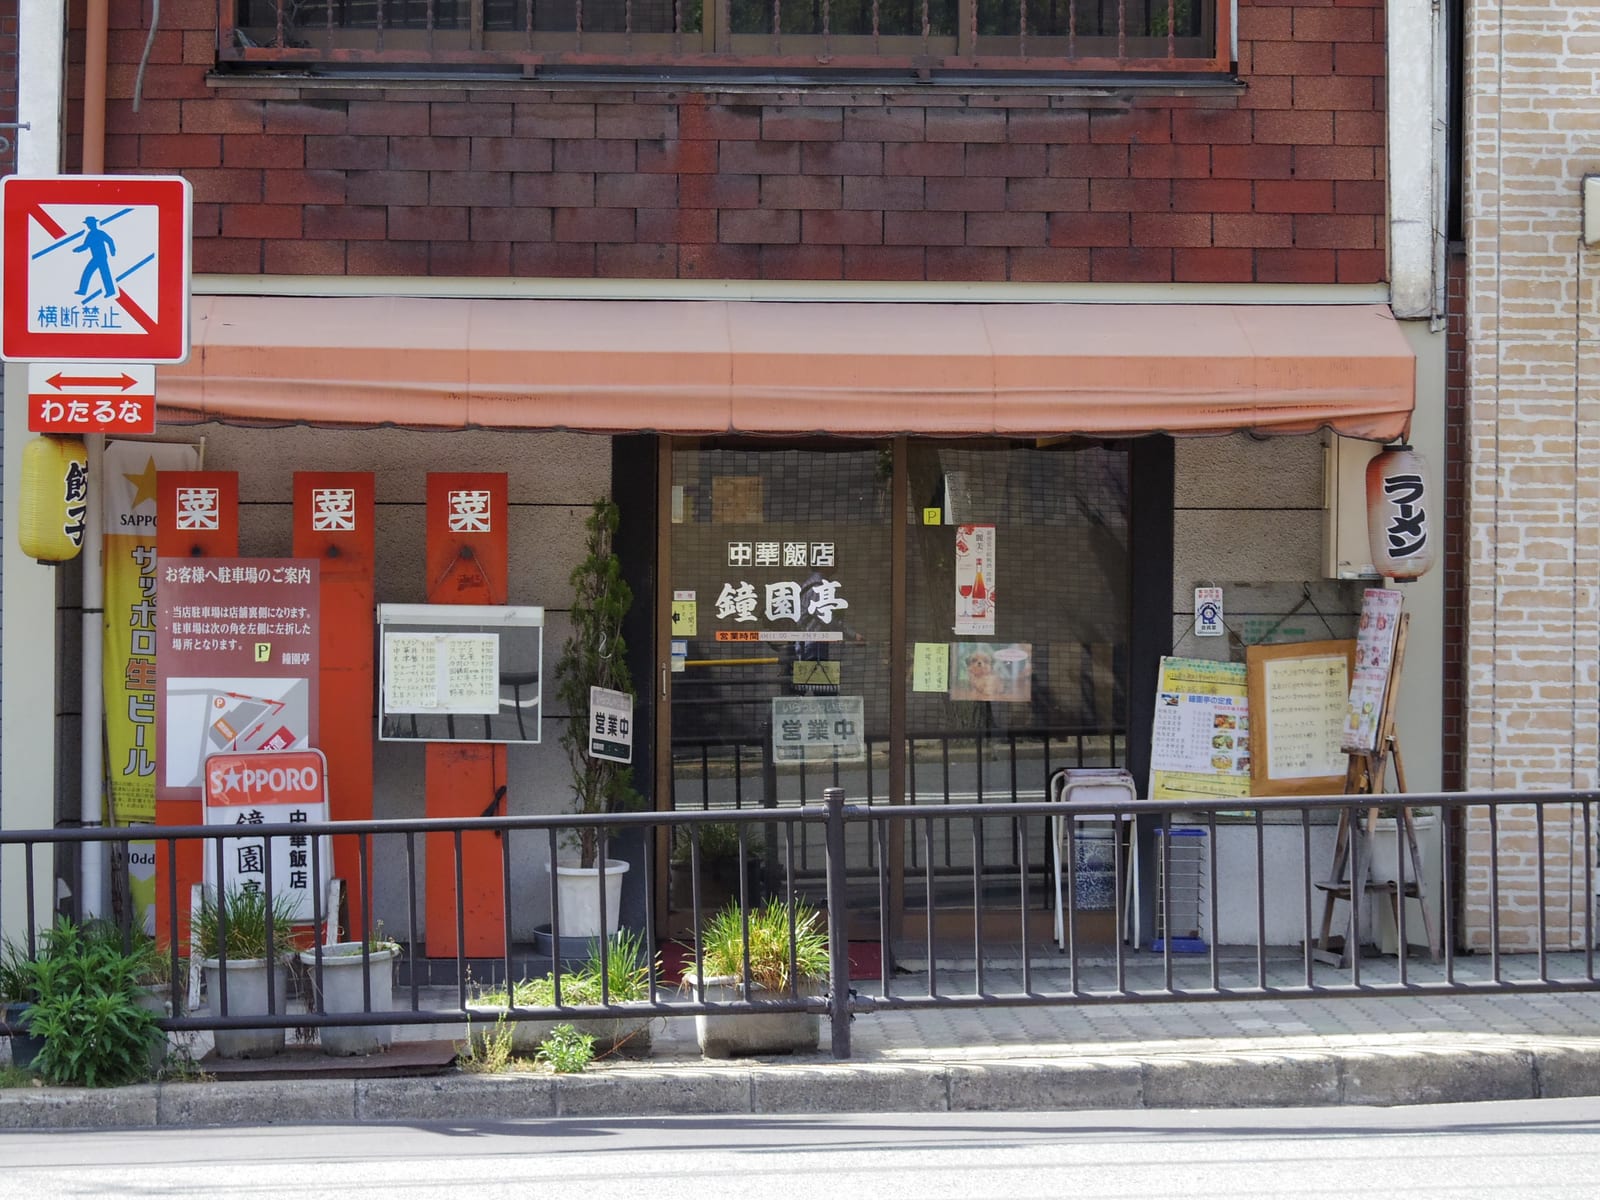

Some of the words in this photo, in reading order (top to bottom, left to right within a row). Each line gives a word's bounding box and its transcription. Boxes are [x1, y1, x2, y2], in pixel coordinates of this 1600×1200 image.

[37, 305, 122, 329] 横断禁止
[40, 399, 142, 424] わたるな
[176, 488, 219, 529] 菜
[312, 489, 355, 530] 菜
[448, 490, 491, 532] 菜
[927, 510, 937, 523] P
[1384, 475, 1427, 558] ラーメン
[728, 542, 835, 566] 中華飯店
[165, 566, 311, 584] お客様へ駐車場のご案内
[714, 579, 849, 624] 鐘園亭
[719, 631, 759, 641] 営業時間
[258, 644, 269, 658] P
[595, 711, 629, 739] 営業中
[781, 718, 856, 741] 営業中
